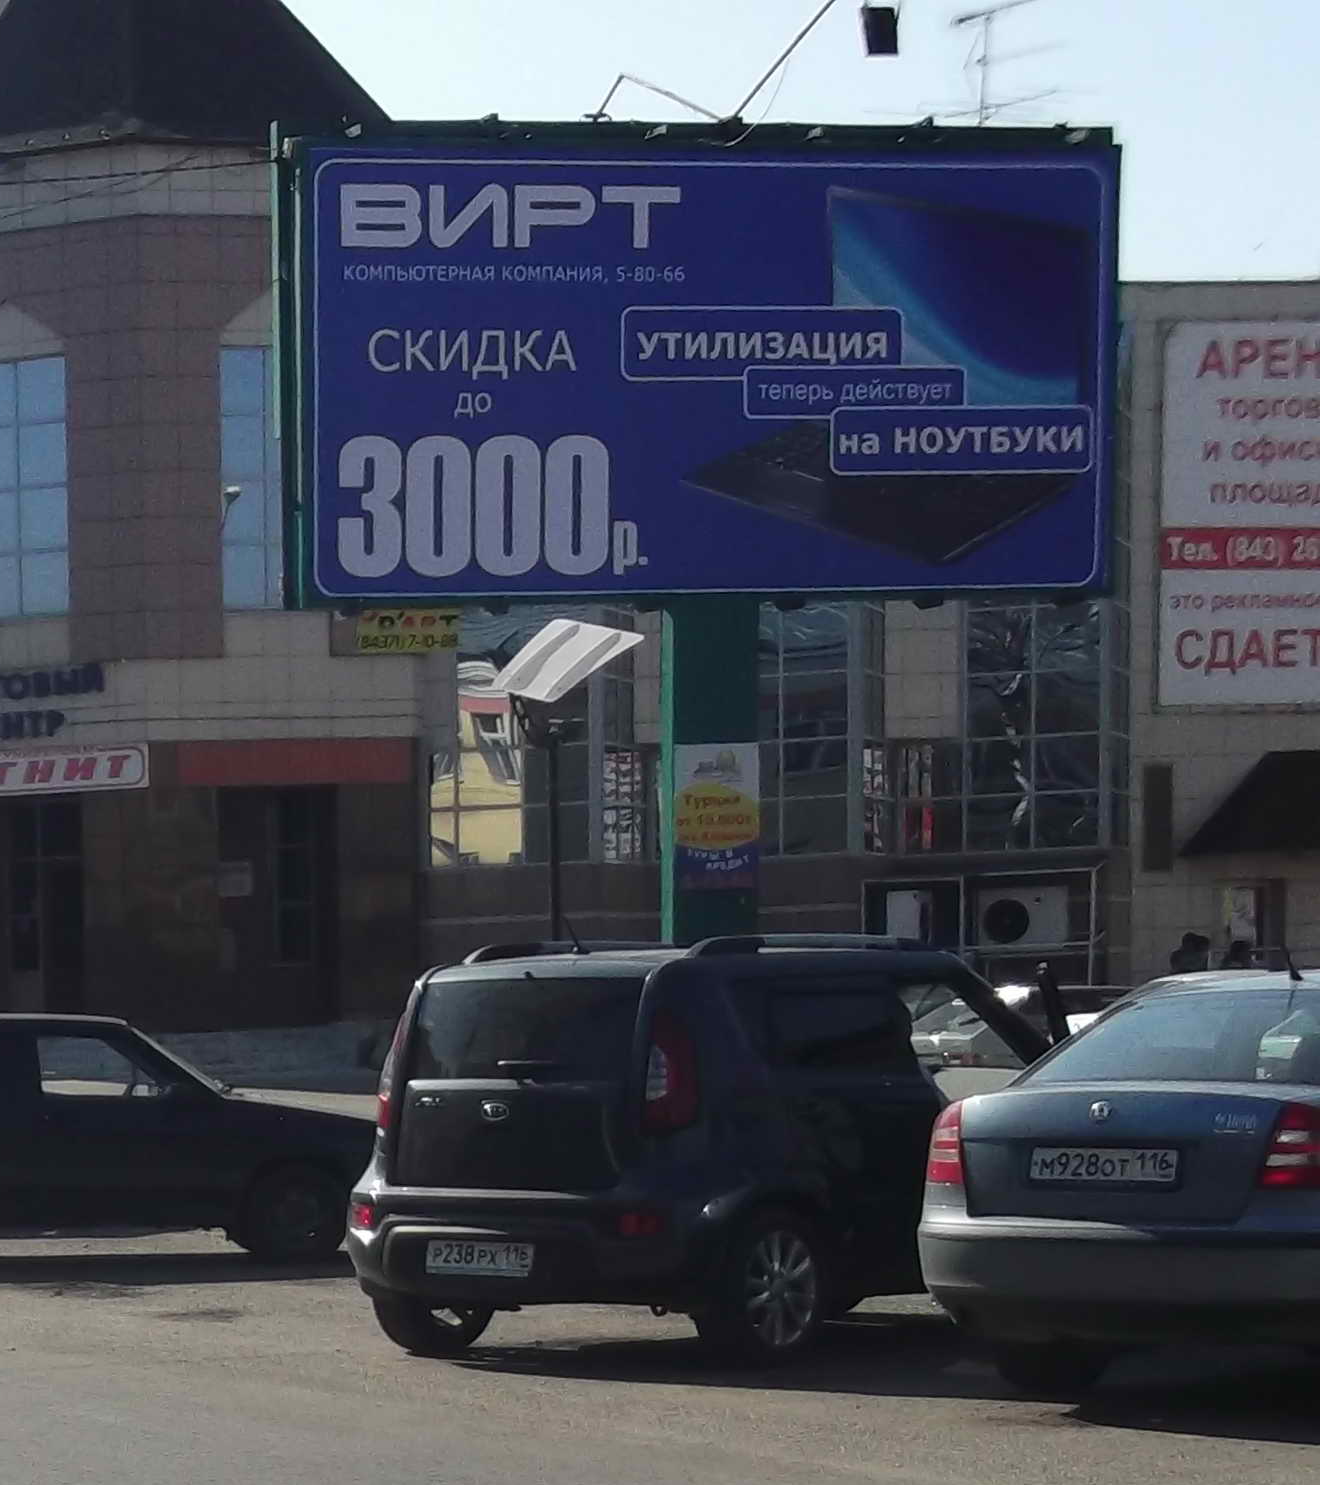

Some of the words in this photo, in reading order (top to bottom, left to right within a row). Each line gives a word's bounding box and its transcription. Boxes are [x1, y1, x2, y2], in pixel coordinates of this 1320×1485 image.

[340, 183, 681, 249] ВИРТ
[343, 265, 495, 282] КОМПЬЮТЕРНАЯ
[502, 266, 609, 284] КОМПАНИЯ,
[616, 267, 686, 283] 5-80-66
[368, 328, 577, 381] СКИДКА
[636, 331, 888, 364] УТИЛИЗАЦИЯ
[1196, 339, 1320, 379] АРЕН
[454, 392, 493, 418] до
[759, 381, 834, 404] теперь
[840, 380, 953, 404] действует
[839, 435, 880, 455] на
[894, 426, 1084, 455] НОУТБУКИ
[1202, 440, 1221, 462] и
[1231, 435, 1320, 467] офис
[338, 434, 609, 578] 3000
[1166, 535, 1218, 562] Тел.
[1226, 534, 1283, 567] (843)
[1169, 594, 1204, 609] это
